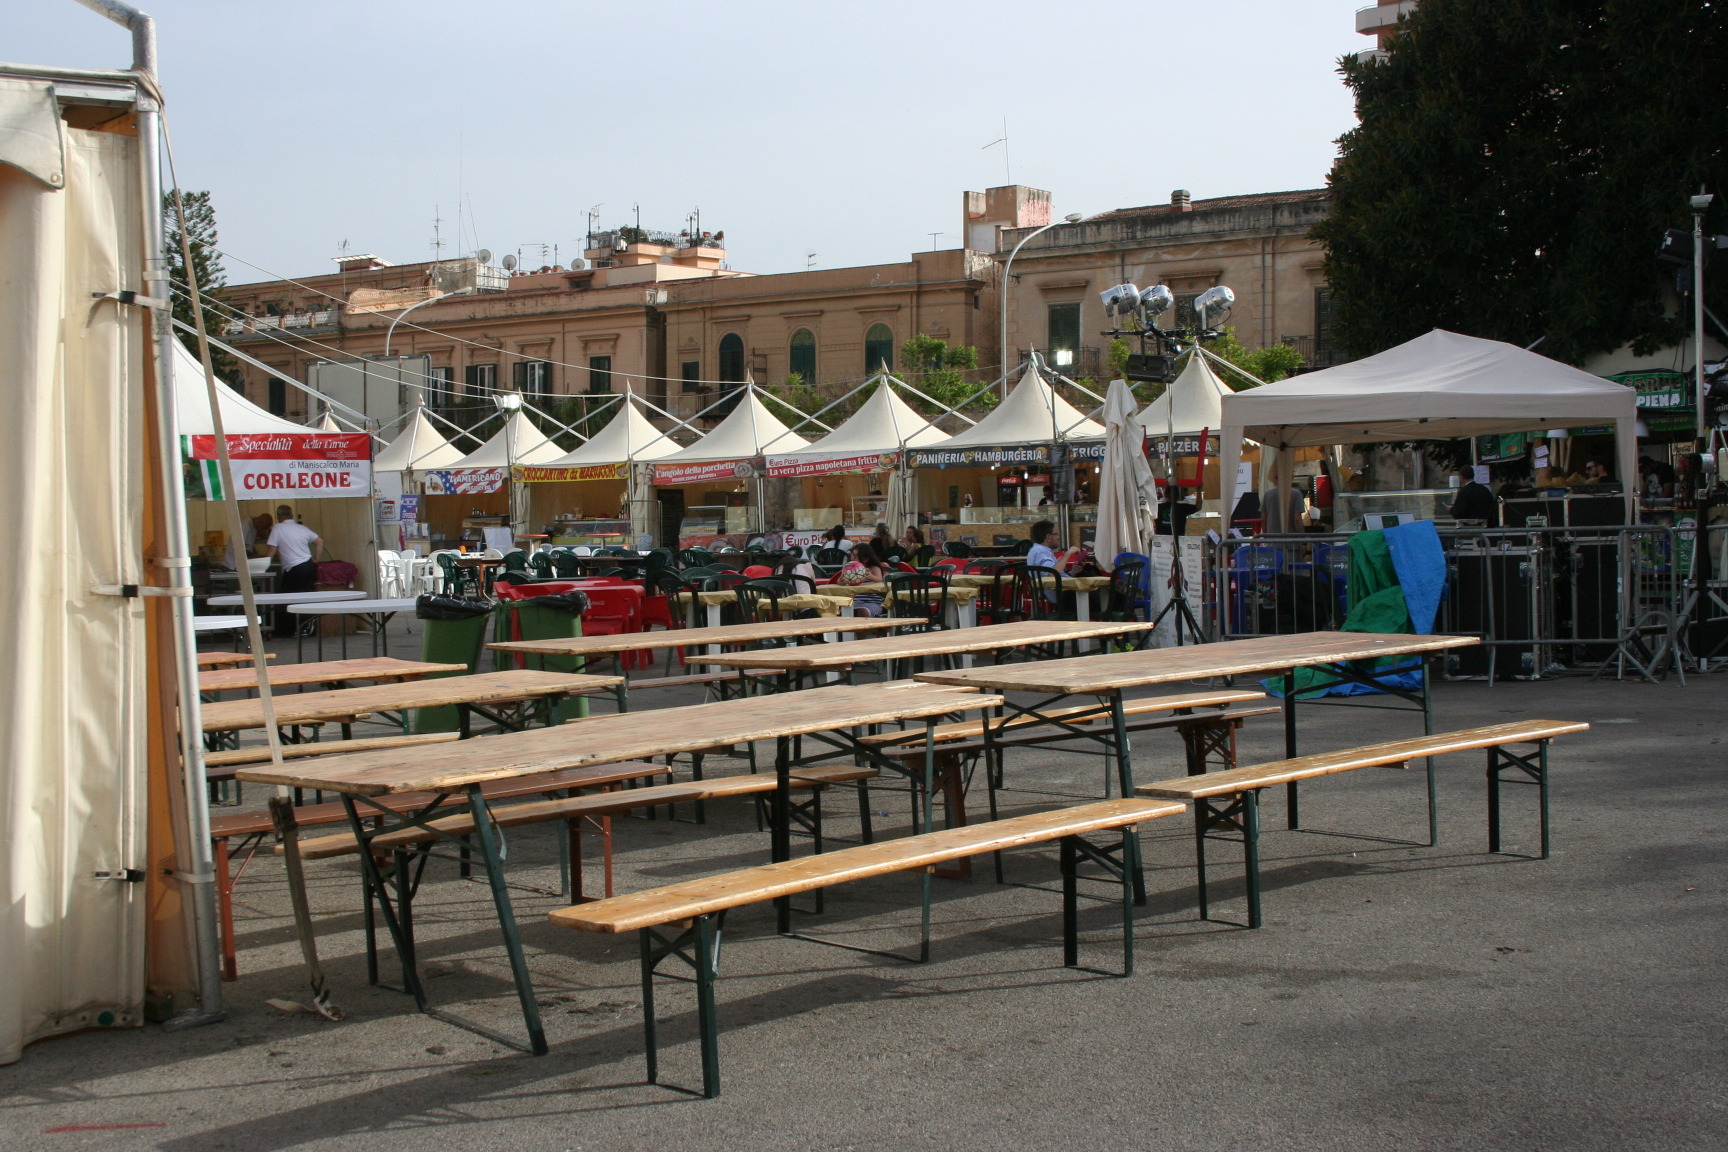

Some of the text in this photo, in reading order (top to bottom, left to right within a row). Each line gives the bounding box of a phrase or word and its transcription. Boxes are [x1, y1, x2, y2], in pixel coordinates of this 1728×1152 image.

[1635, 393, 1680, 407] PIENA
[240, 437, 293, 453] Specialità
[302, 439, 323, 449] della
[324, 439, 350, 449] Carne
[1073, 445, 1106, 458] FRIGG
[1158, 441, 1212, 453] PIZERA
[784, 458, 799, 466] Pizza
[975, 450, 1042, 462] HAMBURGERIA
[289, 461, 360, 469] di Maniscalco Maria
[656, 467, 684, 479] L'angolo
[684, 465, 702, 475] della
[702, 461, 736, 474] porchetta
[769, 468, 778, 476] La
[780, 466, 795, 474] vera
[796, 464, 814, 474] pizza
[815, 460, 856, 472] napoletana
[857, 456, 878, 466] fritta
[243, 472, 351, 490] CORLEONE
